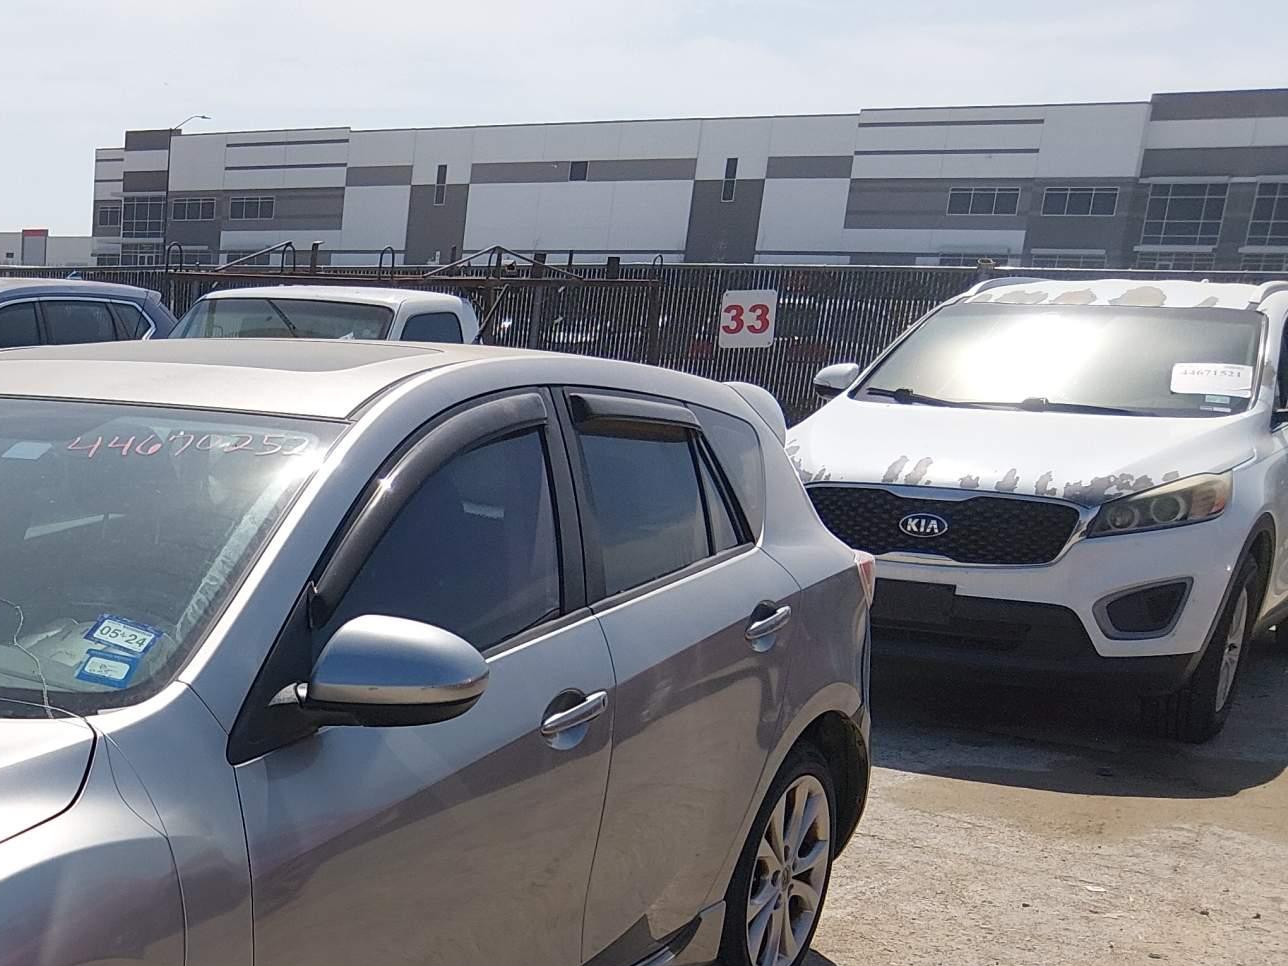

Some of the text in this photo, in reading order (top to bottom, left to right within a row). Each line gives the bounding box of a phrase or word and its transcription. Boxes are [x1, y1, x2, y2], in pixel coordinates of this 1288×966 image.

[721, 303, 770, 335] 33
[67, 432, 310, 458] 44670252
[906, 518, 939, 533] KIA
[99, 625, 147, 648] 05 24
